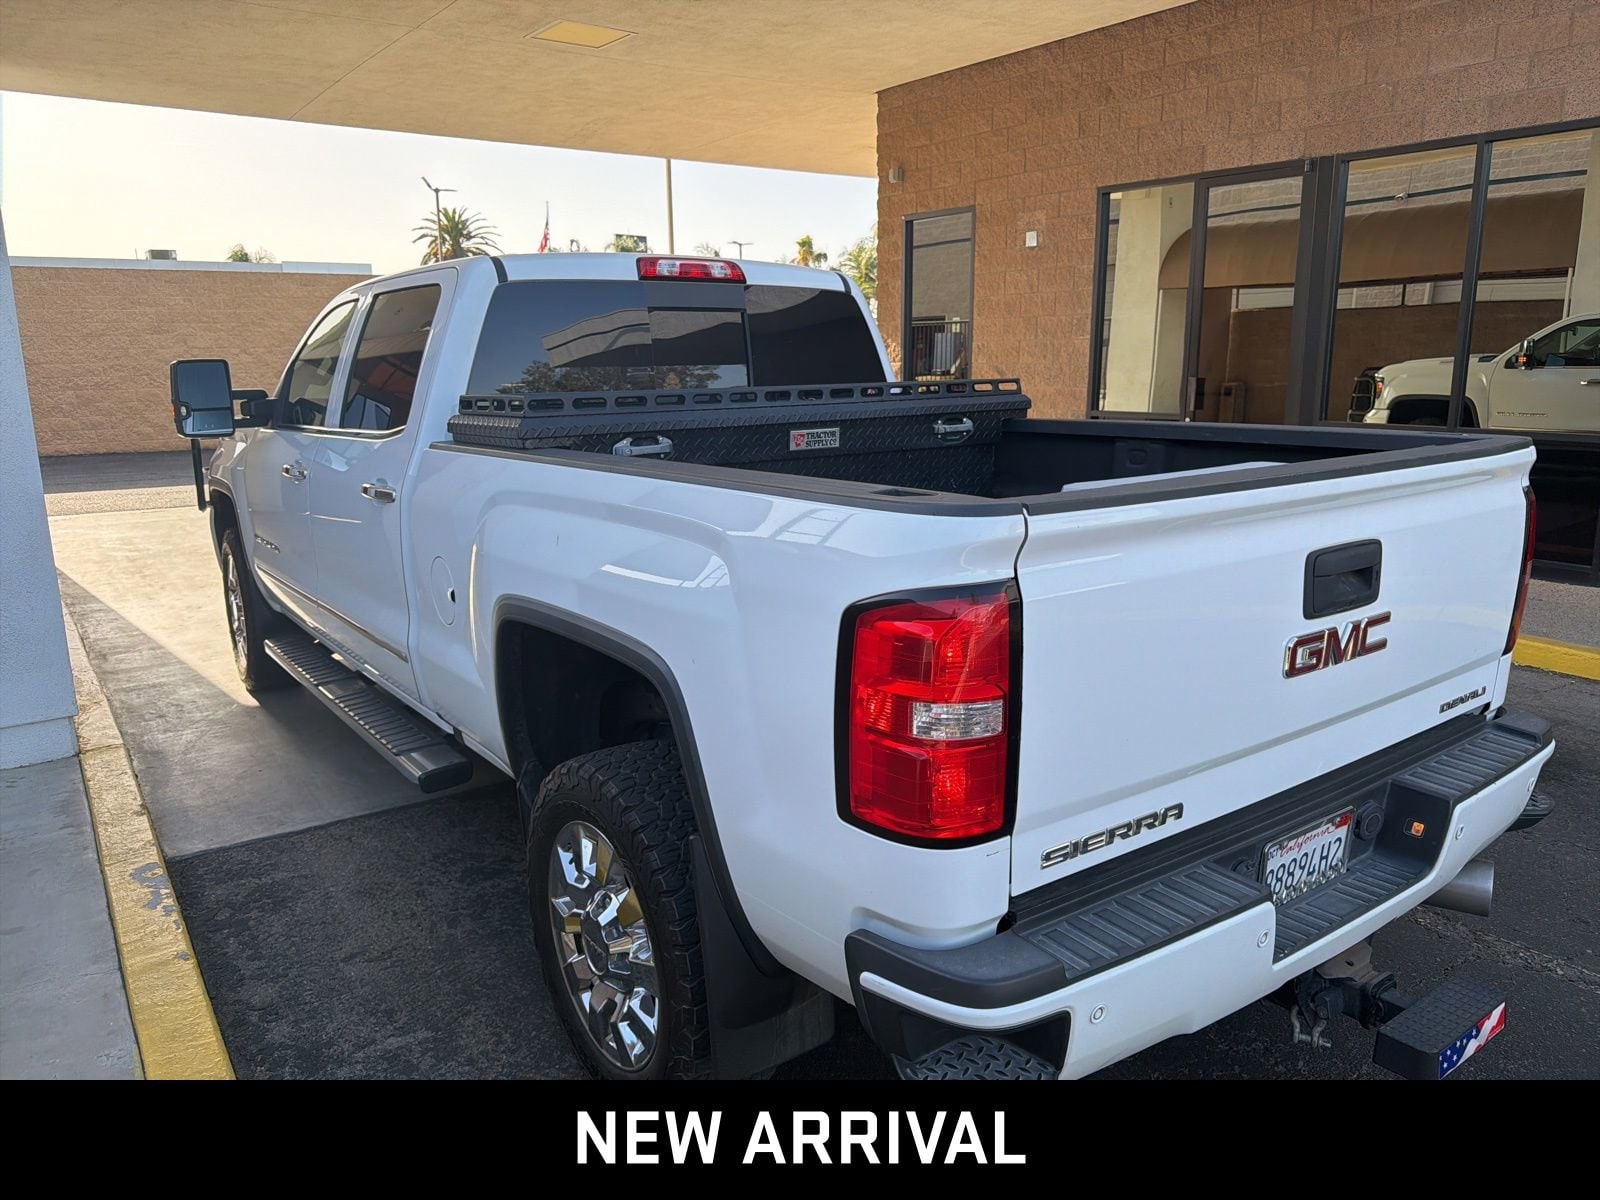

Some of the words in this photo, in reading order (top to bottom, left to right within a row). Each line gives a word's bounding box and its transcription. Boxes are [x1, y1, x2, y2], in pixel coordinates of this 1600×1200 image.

[806, 431, 837, 440] TRACTOR
[806, 439, 829, 448] SUPPLY
[1282, 611, 1391, 679] GMC
[1439, 686, 1486, 714] DENALI
[1040, 802, 1184, 870] SIERRA
